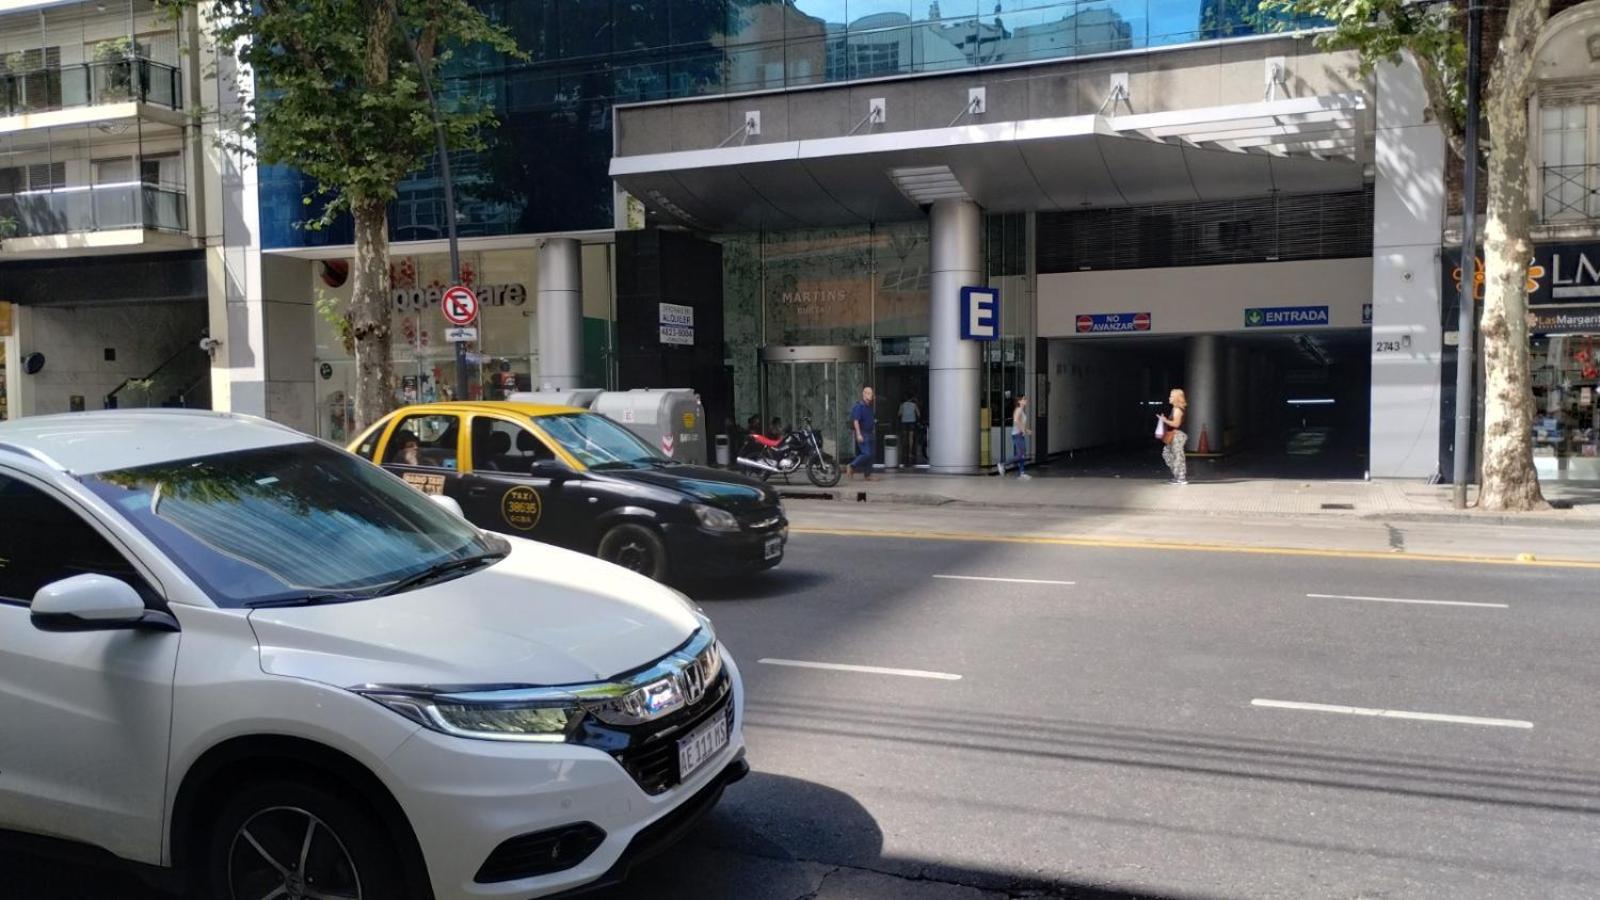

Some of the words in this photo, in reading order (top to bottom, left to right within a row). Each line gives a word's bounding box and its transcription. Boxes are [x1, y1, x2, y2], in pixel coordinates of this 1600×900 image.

[782, 289, 847, 304] MARTINS
[969, 292, 994, 336] E
[1266, 311, 1327, 322] ENTRADA
[1092, 322, 1133, 331] AVANZAR
[1376, 341, 1400, 351] 2743
[512, 491, 533, 500] TAXI
